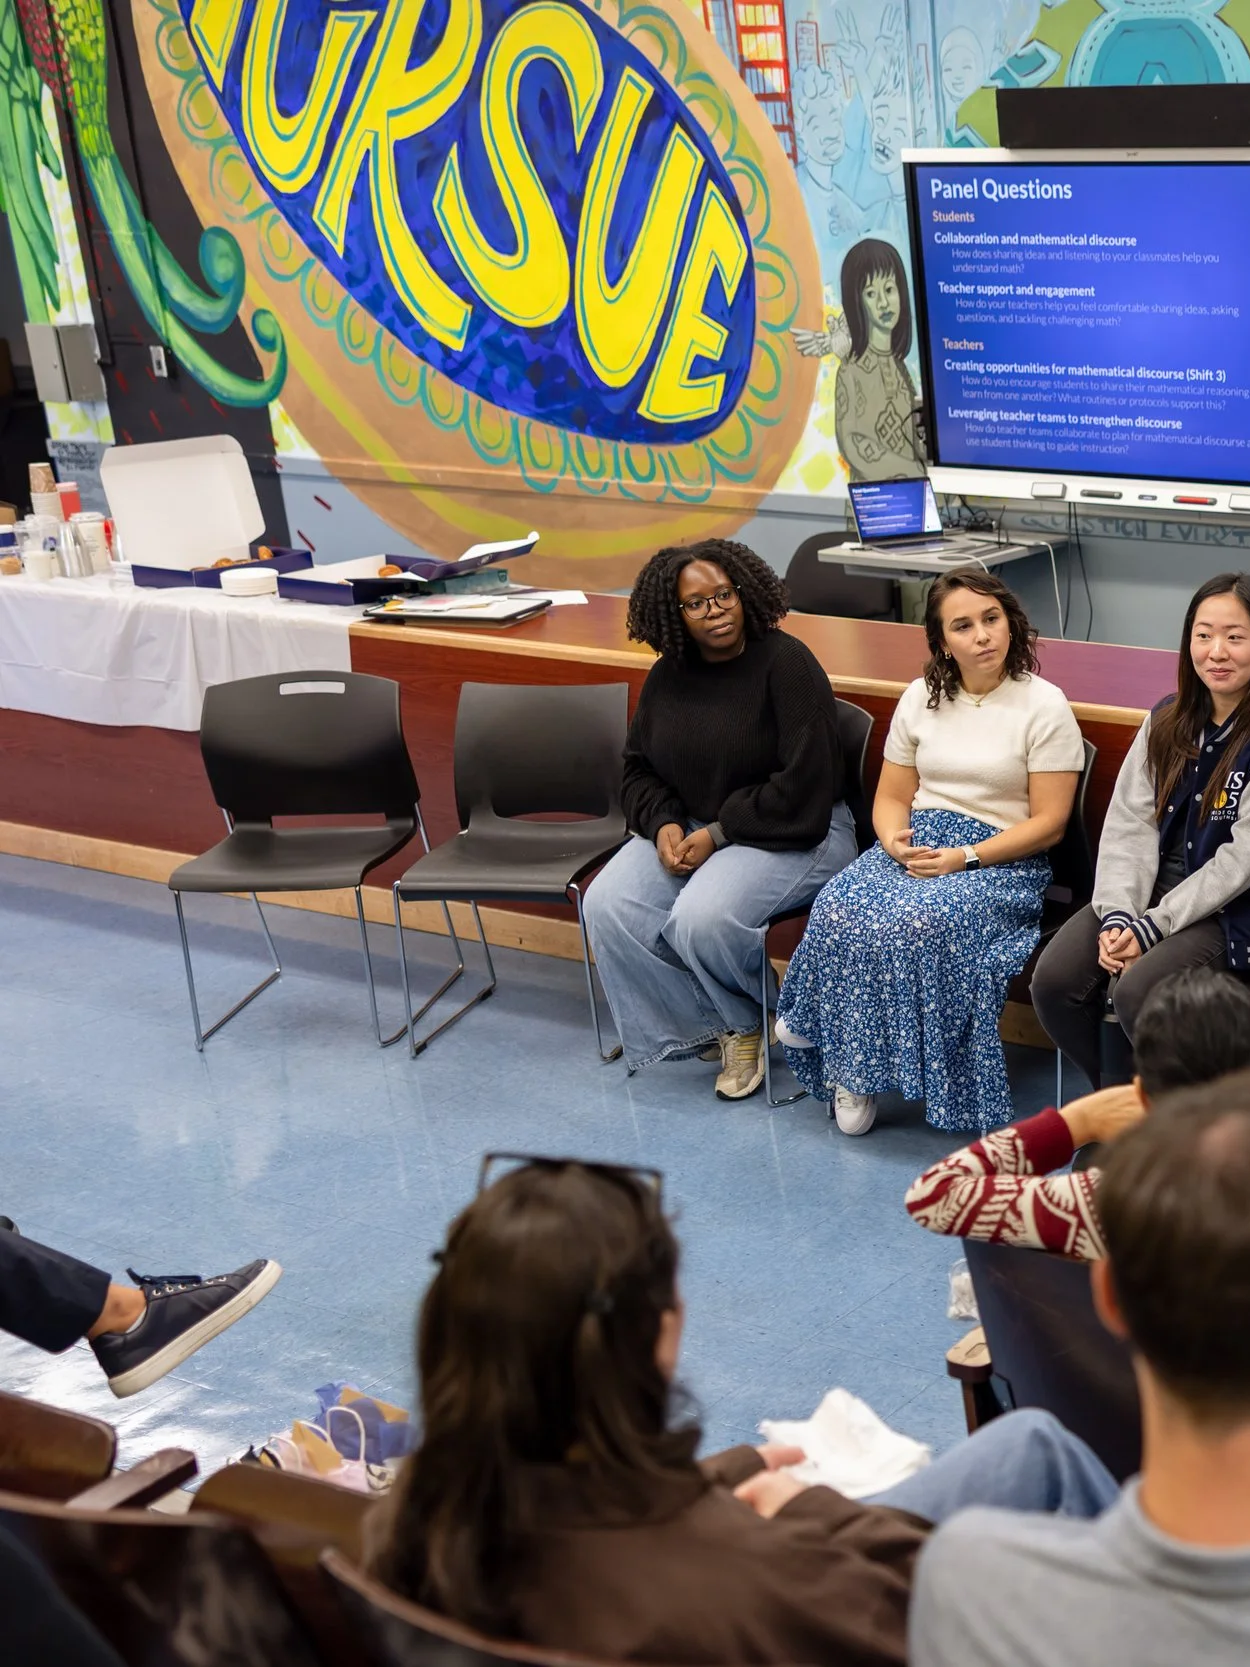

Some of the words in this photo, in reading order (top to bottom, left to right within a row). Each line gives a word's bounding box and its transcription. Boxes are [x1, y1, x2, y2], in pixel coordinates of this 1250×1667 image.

[931, 178, 979, 200] Panel
[982, 178, 1073, 203] Questions
[932, 210, 976, 223] Students
[934, 231, 999, 246] Collaboration
[1001, 232, 1018, 246] and
[1020, 232, 1087, 247] mathematical
[1089, 233, 1137, 248] discourse
[952, 248, 970, 260] How
[972, 249, 991, 260] does
[993, 249, 1023, 262] sharing
[1025, 250, 1047, 261] ideas
[1048, 250, 1063, 261] and
[1065, 250, 1100, 263] listening
[1102, 252, 1110, 262] to
[1112, 253, 1132, 264] your
[1134, 251, 1180, 263] classmates
[1183, 252, 1201, 264] help
[1203, 254, 1220, 265] you
[952, 263, 998, 273] understand
[1000, 263, 1025, 274] math?
[938, 281, 975, 295] Teacher
[977, 283, 1014, 297] support
[1016, 284, 1034, 296] and
[1035, 285, 1096, 300] engagement
[956, 298, 975, 309] How
[977, 298, 987, 309] do
[988, 301, 1006, 311] your
[1008, 300, 1043, 311] teachers
[1044, 301, 1063, 313] help
[1064, 303, 1080, 313] you
[1081, 302, 1097, 313] feel
[1098, 302, 1149, 315] comfortable
[1151, 304, 1183, 317] sharing
[1184, 304, 1210, 316] ideas,
[1211, 305, 1240, 318] asking
[956, 312, 998, 324] questions,
[1000, 314, 1013, 324] and
[1015, 314, 1047, 327] tackling
[1048, 315, 1095, 328] challenging
[1096, 317, 1121, 327] math?
[942, 338, 984, 351] Teachers
[944, 358, 985, 374] Creating
[986, 360, 1051, 375] opportunities
[1052, 363, 1066, 374] for
[1068, 364, 1135, 378] mathematical
[1136, 366, 1185, 380] discourse
[1186, 367, 1213, 382] (Shift
[1216, 369, 1227, 383] 3)
[962, 374, 980, 385] How
[982, 375, 992, 386] do
[993, 378, 1009, 388] you
[1010, 378, 1052, 390] encourage
[1053, 379, 1088, 390] students
[1090, 381, 1099, 390] to
[1101, 381, 1124, 392] share
[1126, 382, 1146, 393] their
[1147, 383, 1205, 396] mathematical
[1207, 386, 1250, 399] reasoning
[962, 388, 983, 399] learn
[984, 388, 1004, 400] from
[1005, 391, 1020, 401] one
[1021, 391, 1057, 402] another?
[1058, 392, 1080, 403] What
[1082, 394, 1117, 405] routines
[1118, 397, 1128, 405] or
[1129, 396, 1169, 409] protocols
[1171, 399, 1204, 411] support
[1206, 399, 1226, 411] this?
[948, 406, 998, 423] Leveraging
[1000, 409, 1035, 422] teacher
[1037, 411, 1066, 424] teams
[1068, 413, 1078, 424] to
[1080, 413, 1133, 428] strengthen
[1135, 415, 1183, 430] discourse
[965, 422, 984, 433] How
[985, 423, 996, 434] do
[997, 424, 1026, 435] teacher
[1028, 426, 1053, 437] teams
[1054, 427, 1100, 440] collaborate
[1101, 430, 1110, 440] to
[1112, 430, 1130, 443] plan
[1131, 431, 1143, 442] for
[1144, 432, 1202, 446] mathematical
[1203, 435, 1245, 448] discourse
[966, 438, 980, 448] use
[981, 437, 1011, 449] student
[1013, 439, 1046, 452] thinking
[1047, 441, 1056, 450] to
[1057, 442, 1079, 453] guide
[1080, 444, 1129, 456] instruction?
[1225, 791, 1240, 809] 5
